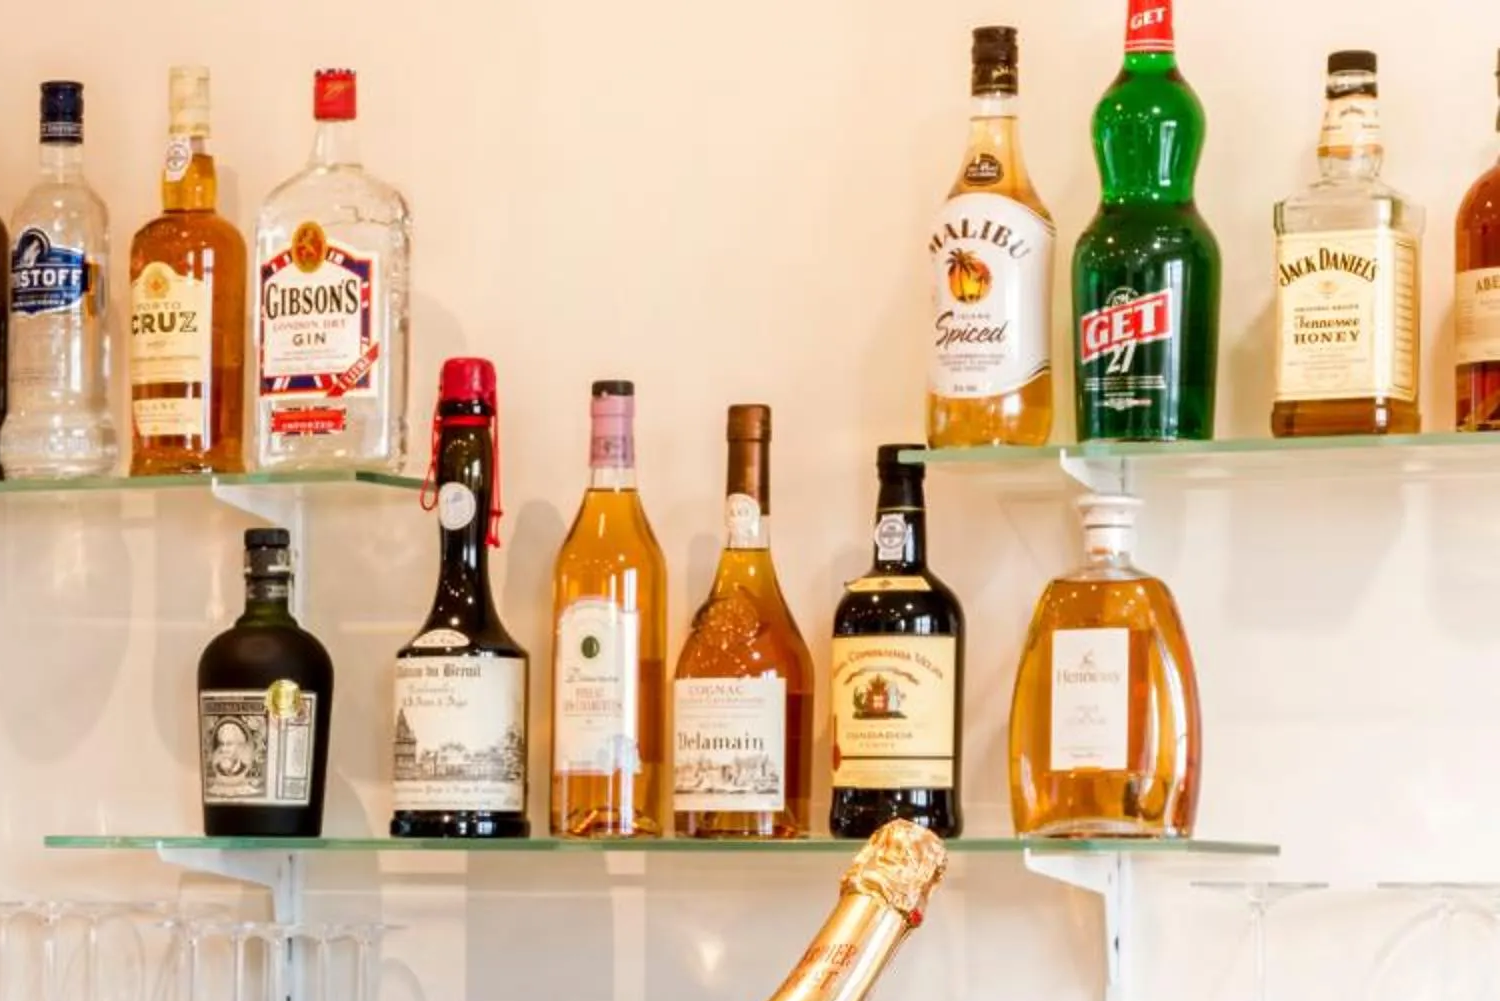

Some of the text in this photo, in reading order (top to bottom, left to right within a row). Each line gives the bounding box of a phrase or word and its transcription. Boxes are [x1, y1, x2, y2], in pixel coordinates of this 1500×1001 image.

[1130, 7, 1167, 30] GET
[1279, 256, 1316, 287] JACK
[265, 279, 358, 319] GIBSON'S
[293, 332, 326, 347] GIN
[935, 310, 1009, 350] Spiced
[1086, 299, 1164, 350] GET
[1294, 330, 1360, 345] HONEY
[1105, 339, 1137, 374] 27
